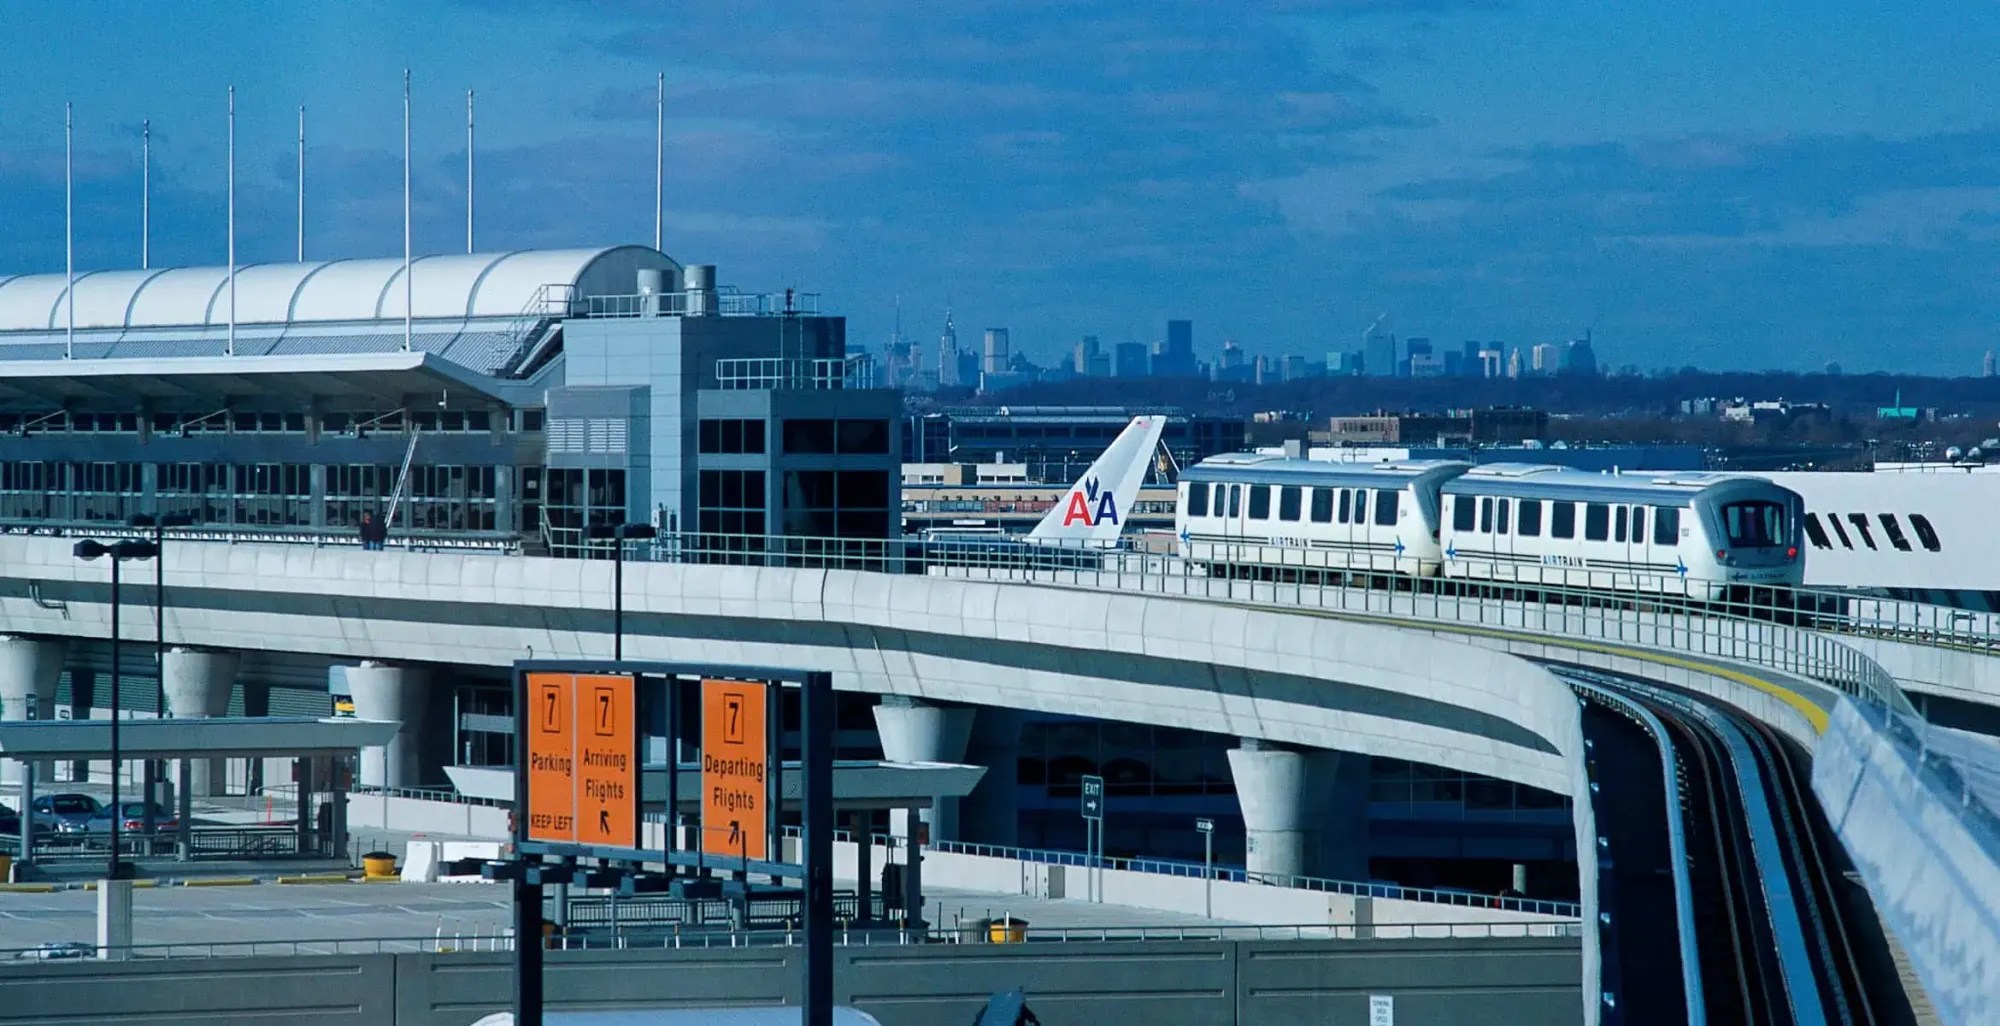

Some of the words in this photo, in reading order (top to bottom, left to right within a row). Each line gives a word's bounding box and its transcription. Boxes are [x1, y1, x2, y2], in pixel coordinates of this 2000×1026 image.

[1063, 490, 1119, 526] AA
[1270, 535, 1309, 548] AIRTRAIN
[1803, 512, 1942, 552] NITED
[1542, 554, 1584, 568] AIRTRAIN
[547, 692, 556, 726] 7
[600, 695, 609, 728] 7
[729, 702, 739, 736] 7
[531, 751, 572, 777] Parking
[583, 747, 627, 773] Arriving
[704, 753, 764, 783] Departing
[585, 777, 625, 803] Flights
[713, 786, 755, 812] Flights
[1085, 783, 1099, 796] EXIT
[530, 813, 552, 830] KEEP
[553, 814, 574, 831] LEFT
